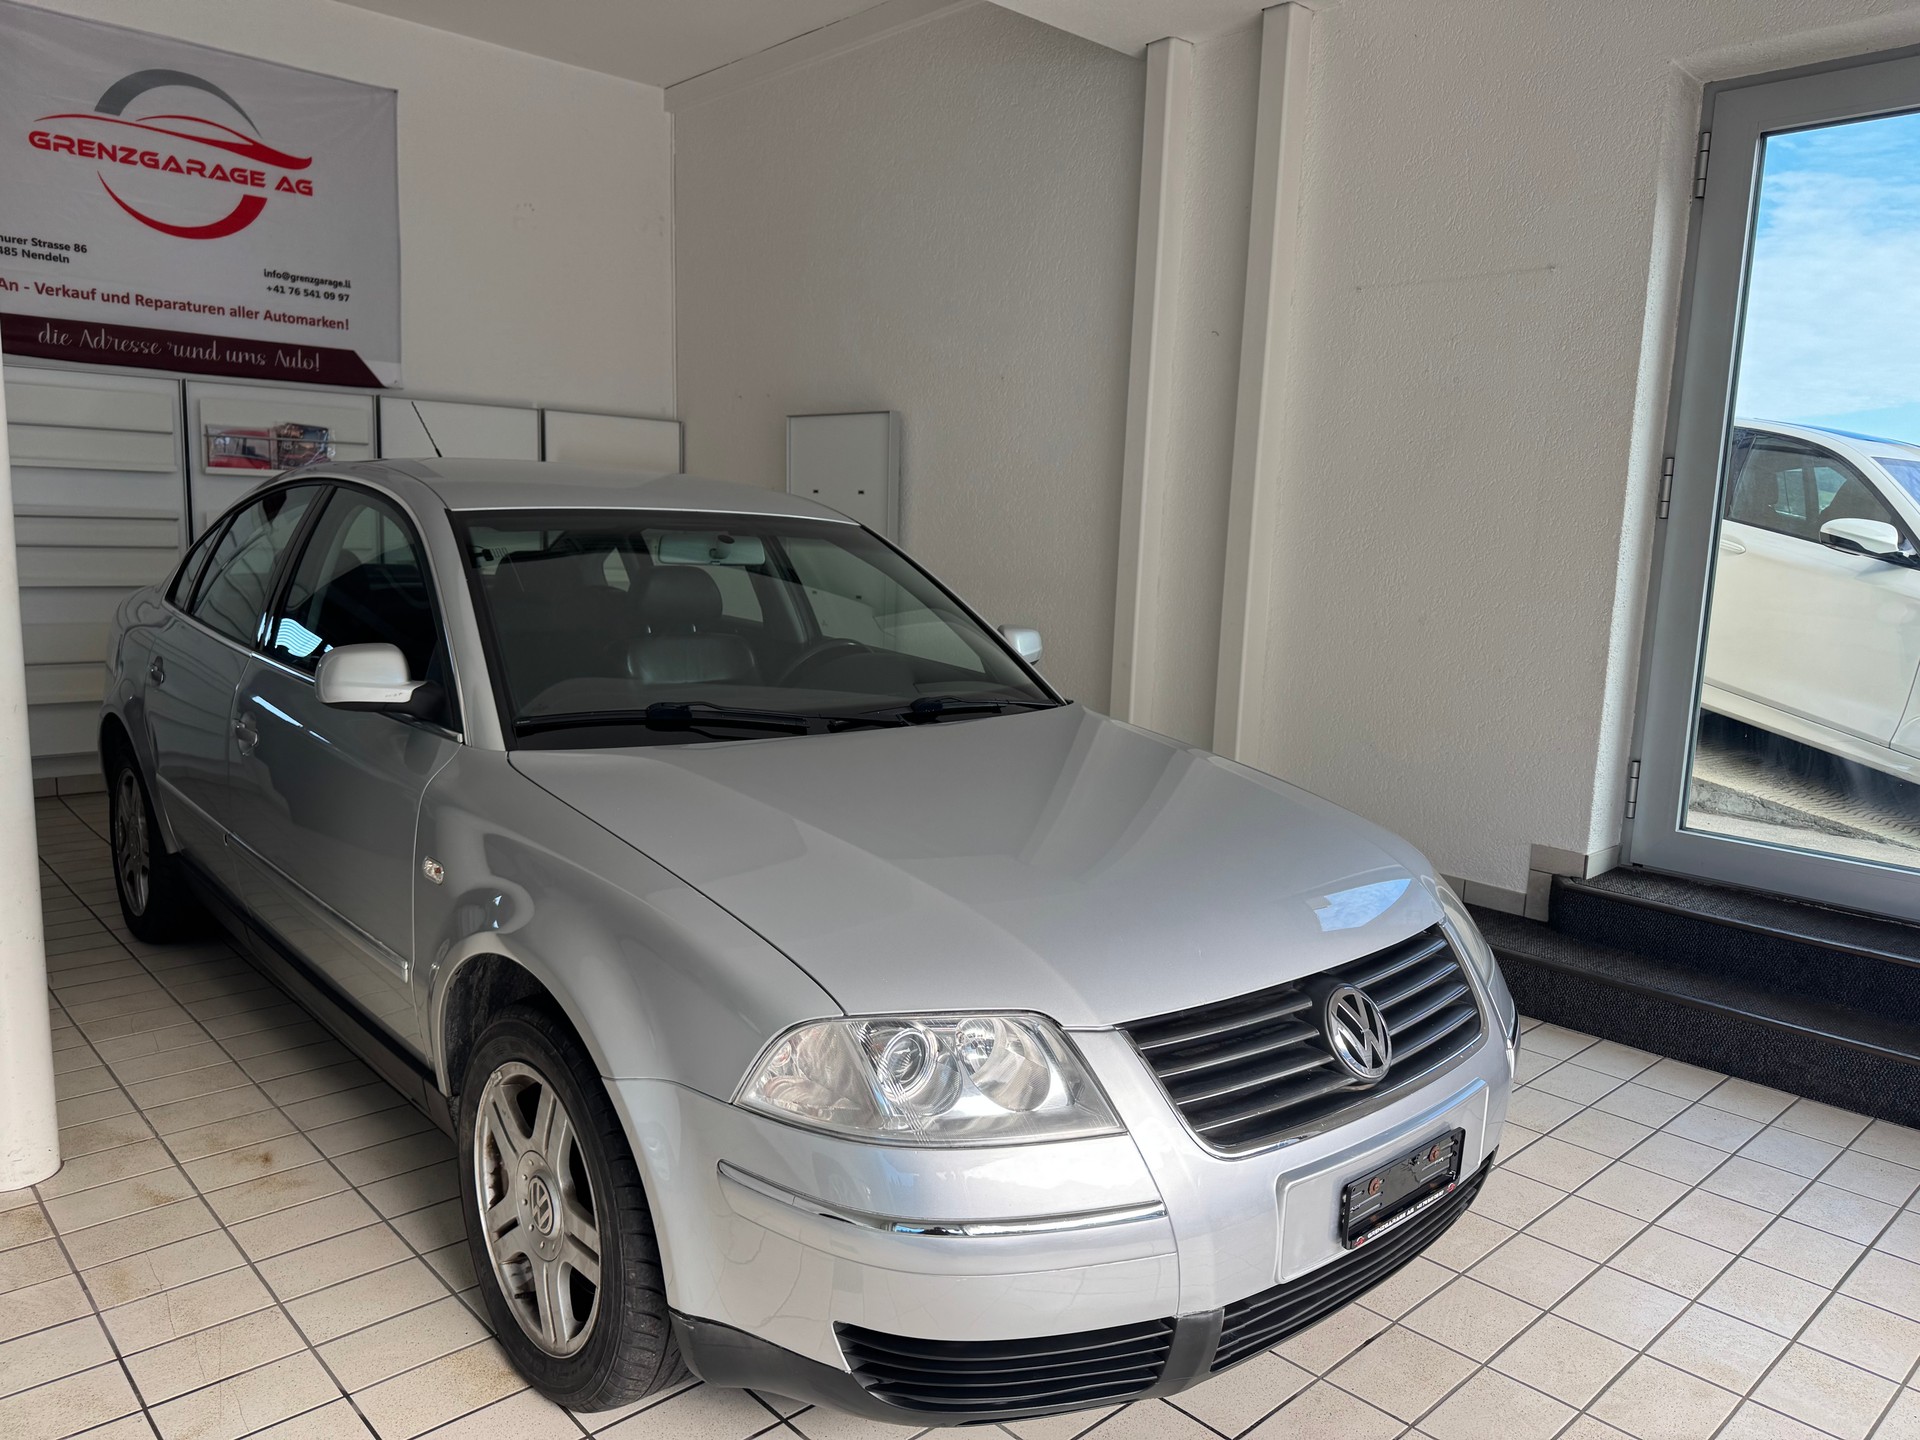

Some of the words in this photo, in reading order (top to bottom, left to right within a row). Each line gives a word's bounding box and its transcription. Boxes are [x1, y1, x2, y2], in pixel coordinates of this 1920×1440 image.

[28, 130, 266, 188] GRENZGARAGE
[275, 176, 313, 197] AG
[31, 237, 71, 251] Strasse
[73, 243, 88, 254] 86
[22, 249, 70, 264] Nendeln
[263, 268, 351, 289] info@grenzgarage.li
[266, 284, 286, 294] +41
[288, 286, 301, 296] 76
[303, 288, 321, 299] 541
[323, 291, 336, 300] 09
[338, 293, 350, 302] 97
[0, 277, 19, 292] An
[34, 281, 97, 301] Verkauf
[101, 292, 130, 305] und
[135, 293, 225, 316] Reparaturen
[229, 305, 260, 320] aller
[263, 309, 350, 331] Automarken!
[38, 323, 73, 346] die
[79, 328, 162, 355] Adresse
[167, 340, 221, 362] rund
[226, 350, 266, 366] ums
[274, 349, 320, 372] Auto!
